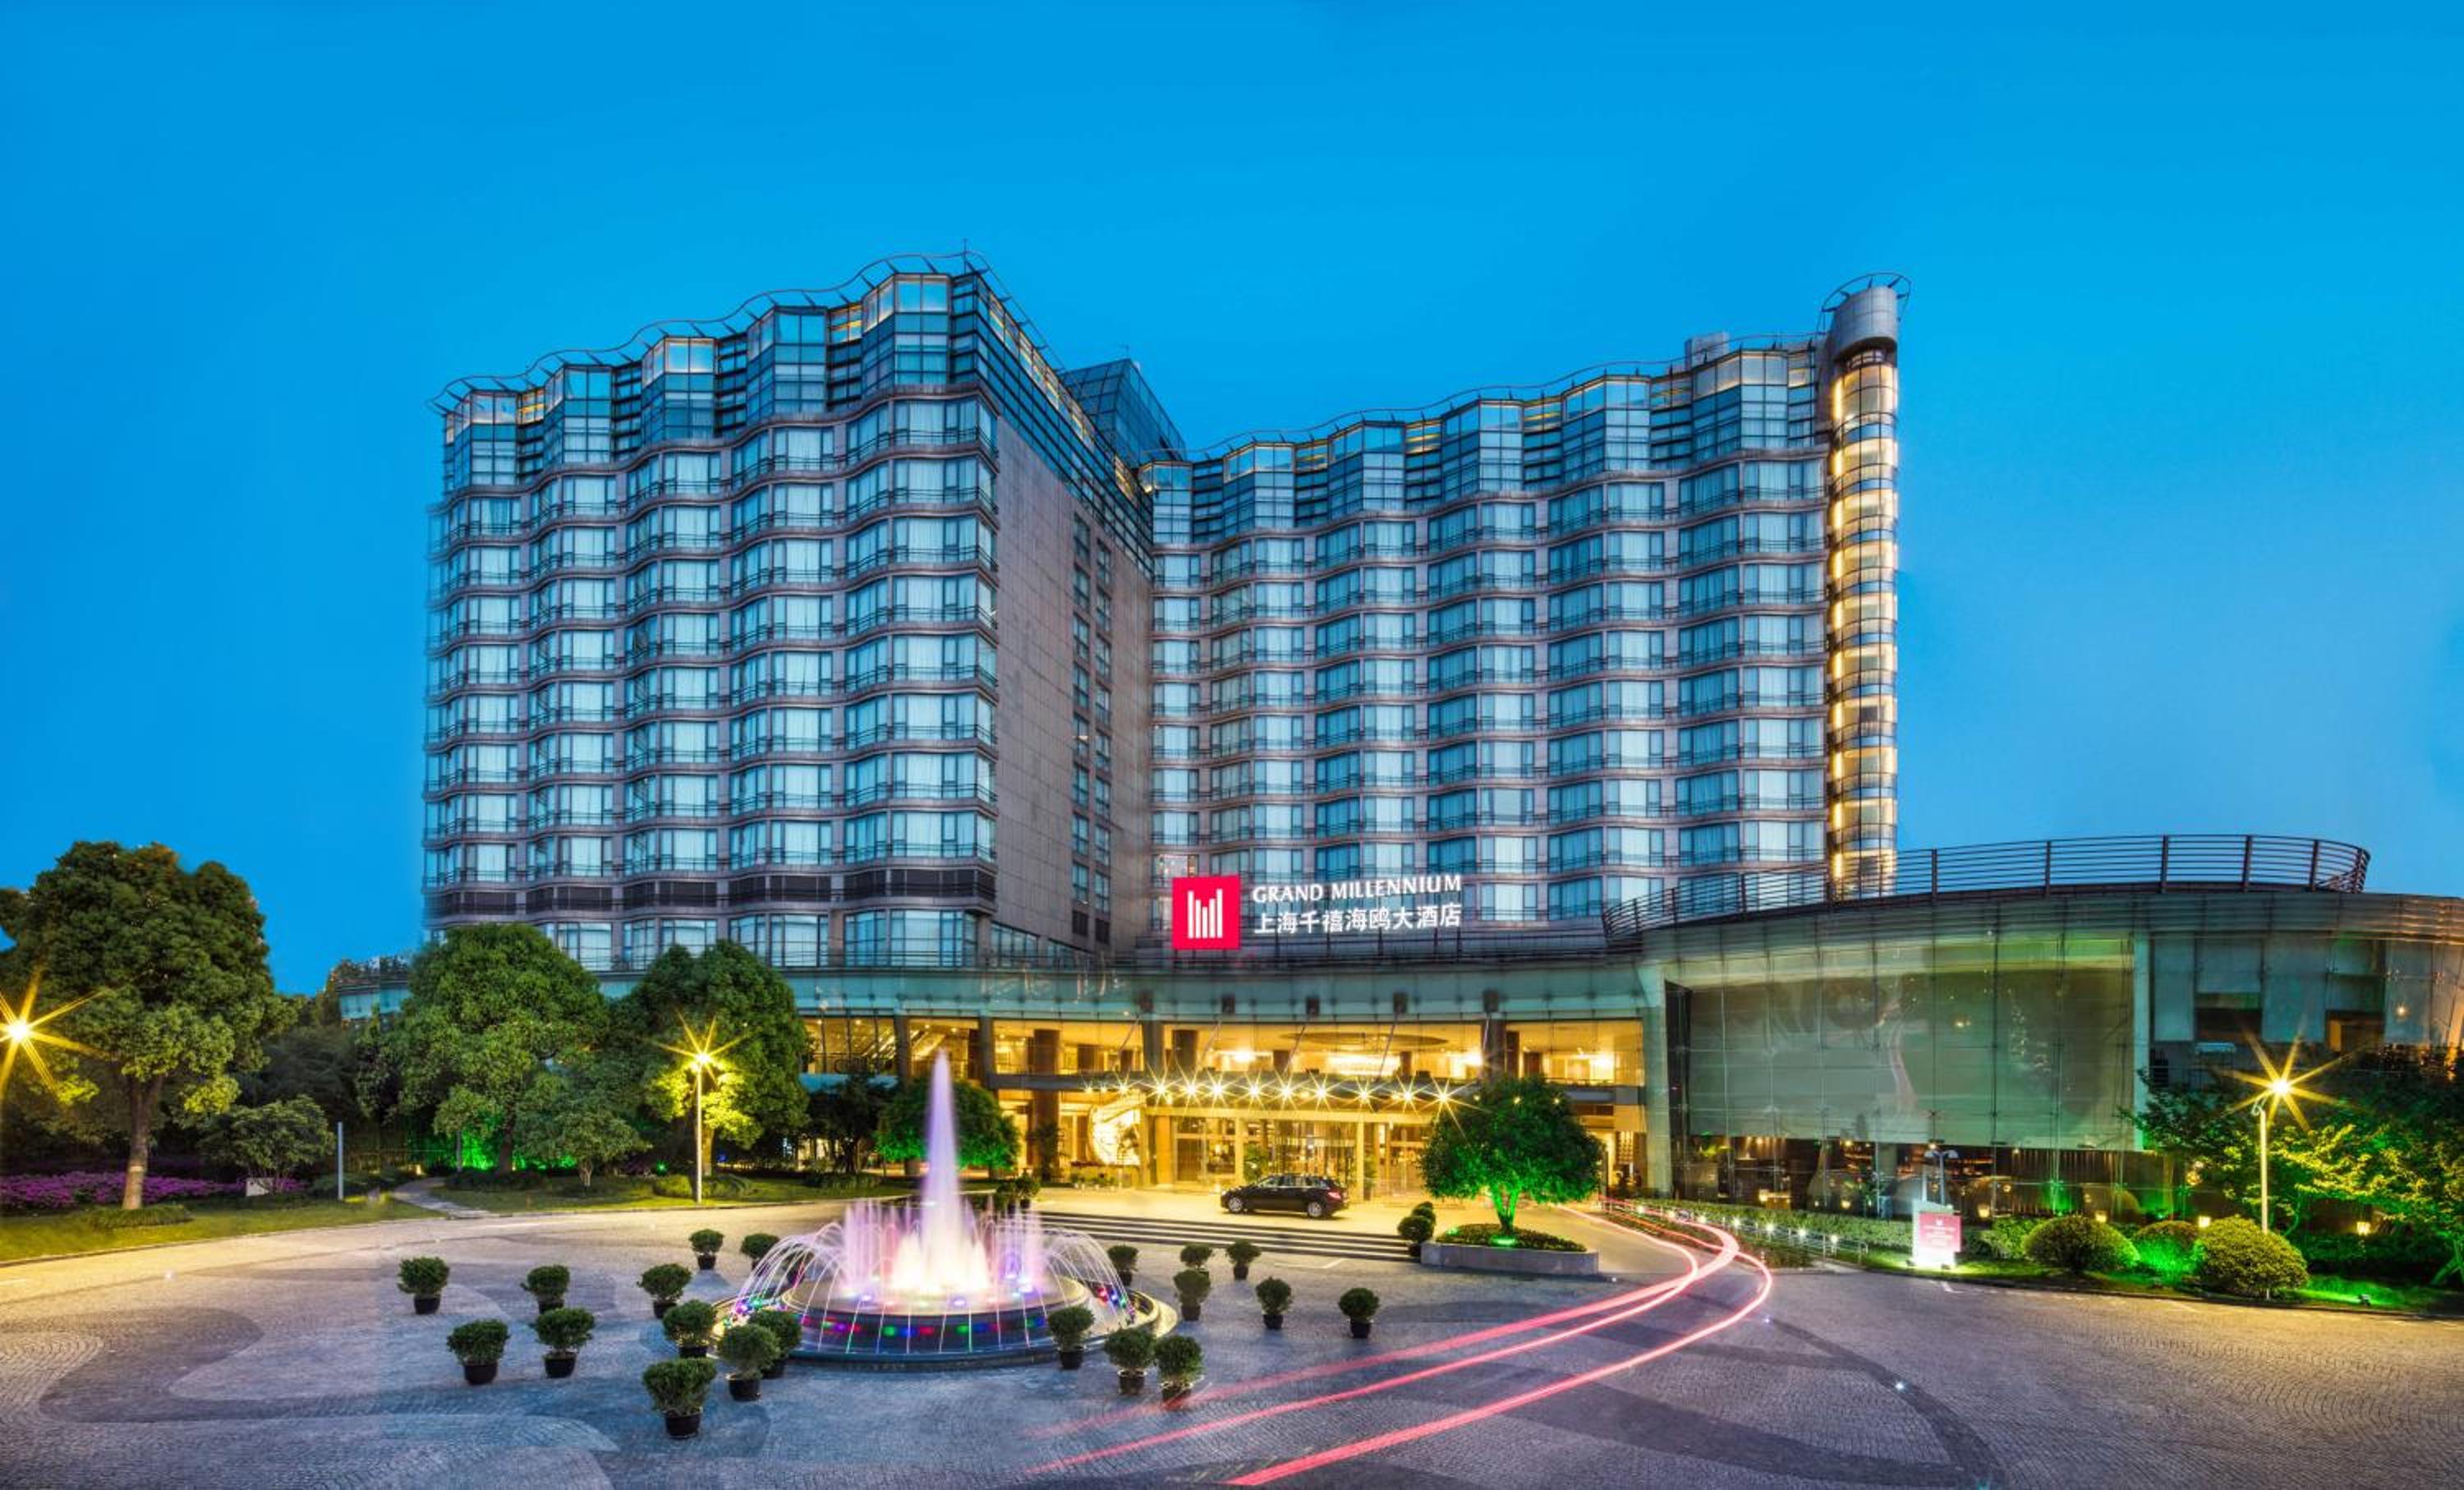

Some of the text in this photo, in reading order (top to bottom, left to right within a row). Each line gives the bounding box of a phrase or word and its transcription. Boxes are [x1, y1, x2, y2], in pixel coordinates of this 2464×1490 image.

[1253, 875, 1462, 903] GRAND MILLENNIUM
[1254, 903, 1462, 934] 上海千禧海鸥大酒店
